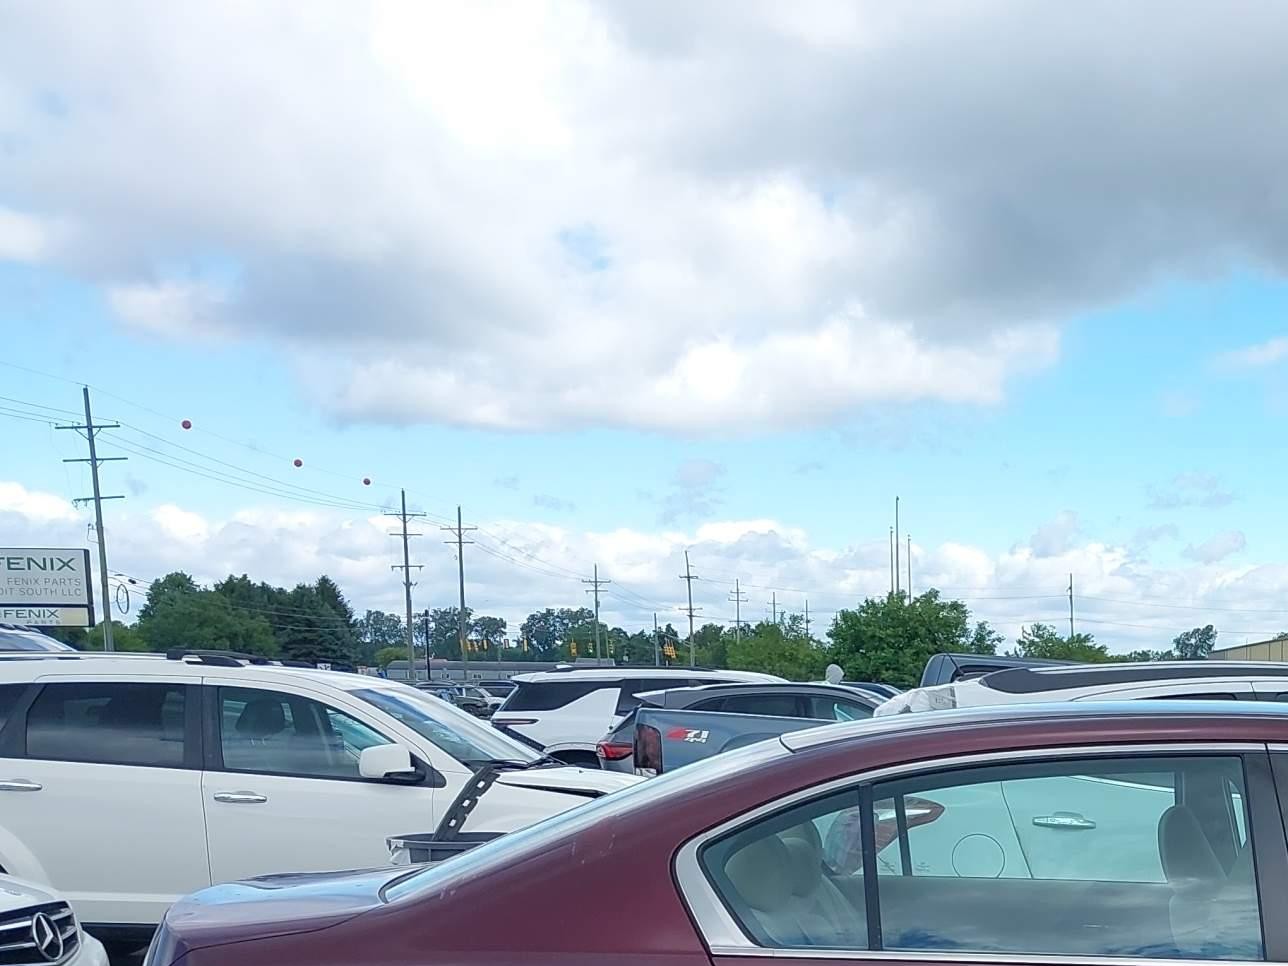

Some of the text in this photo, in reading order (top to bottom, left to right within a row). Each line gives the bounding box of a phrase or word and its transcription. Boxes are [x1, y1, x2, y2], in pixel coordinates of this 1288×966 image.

[0, 557, 76, 571] ENIX
[7, 578, 81, 586] FENIX PARTS
[20, 587, 57, 596] SOUTH
[62, 588, 81, 596] LLC
[3, 609, 59, 618] FENIX
